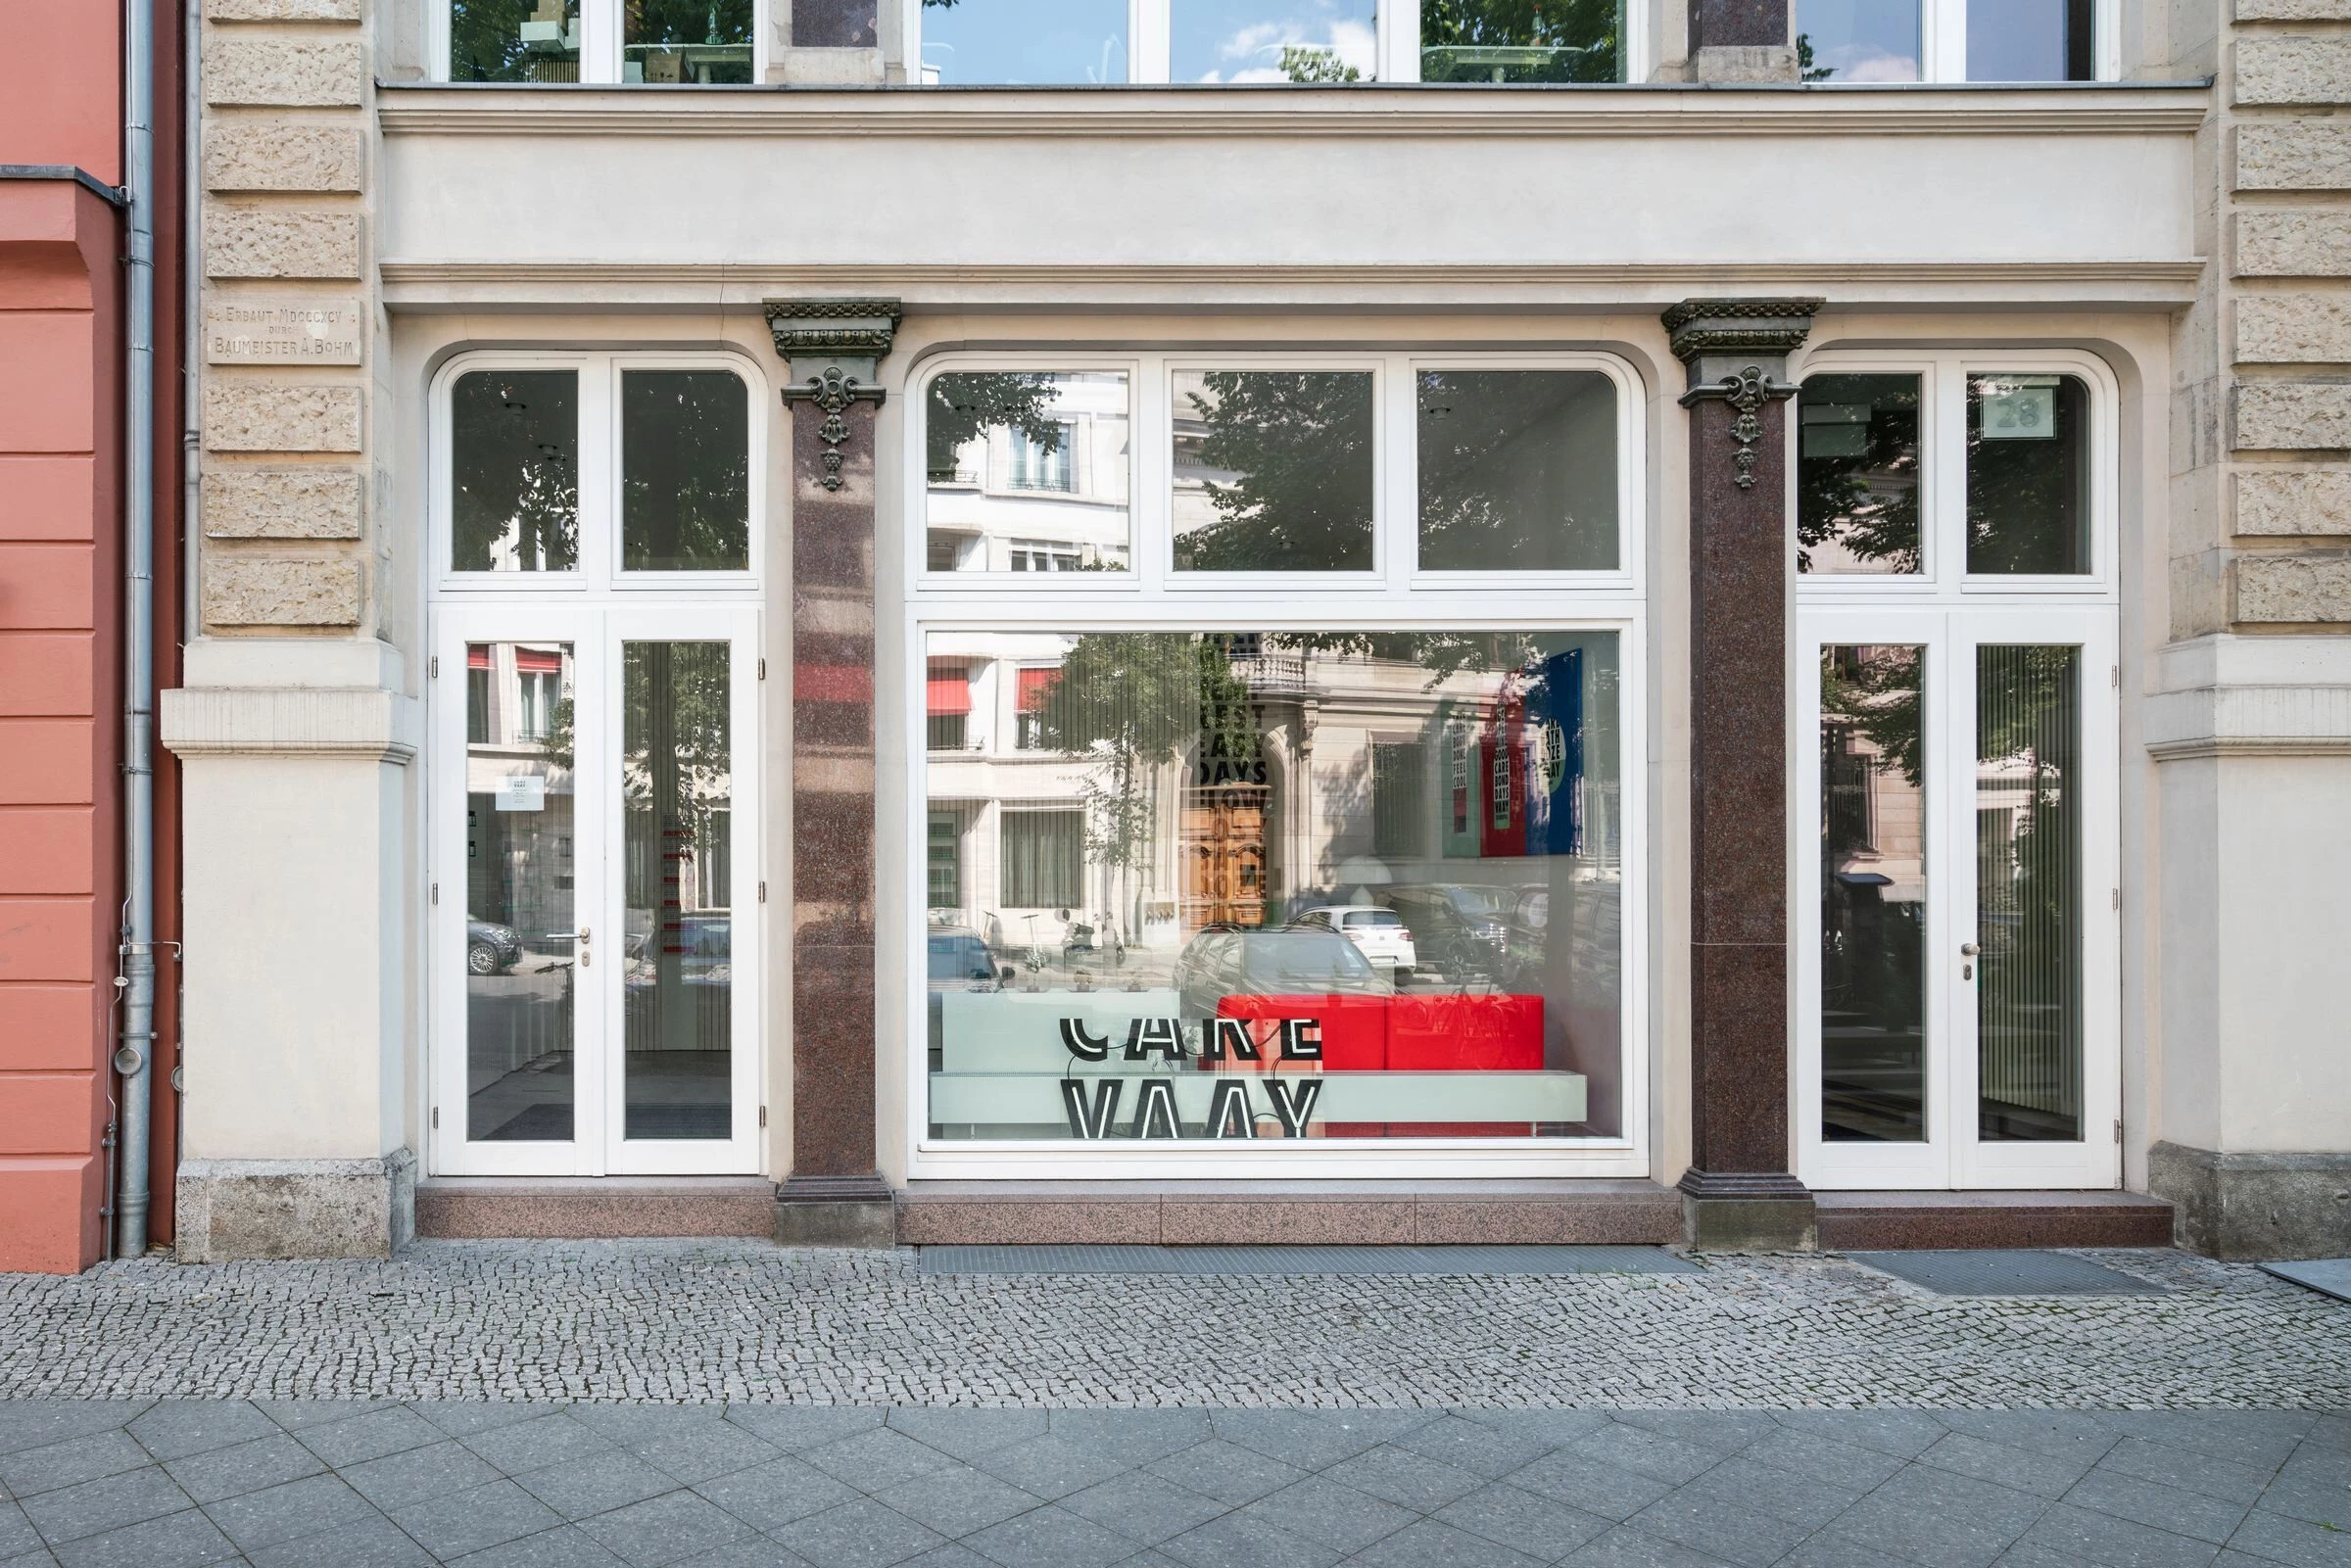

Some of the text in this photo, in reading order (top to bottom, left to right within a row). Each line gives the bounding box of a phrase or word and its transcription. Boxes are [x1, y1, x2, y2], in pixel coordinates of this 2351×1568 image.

[1996, 399, 2039, 428] 28
[1200, 761, 1268, 786] DAYS
[1060, 1019, 1323, 1062] CARE
[1060, 1079, 1324, 1139] VAAY
